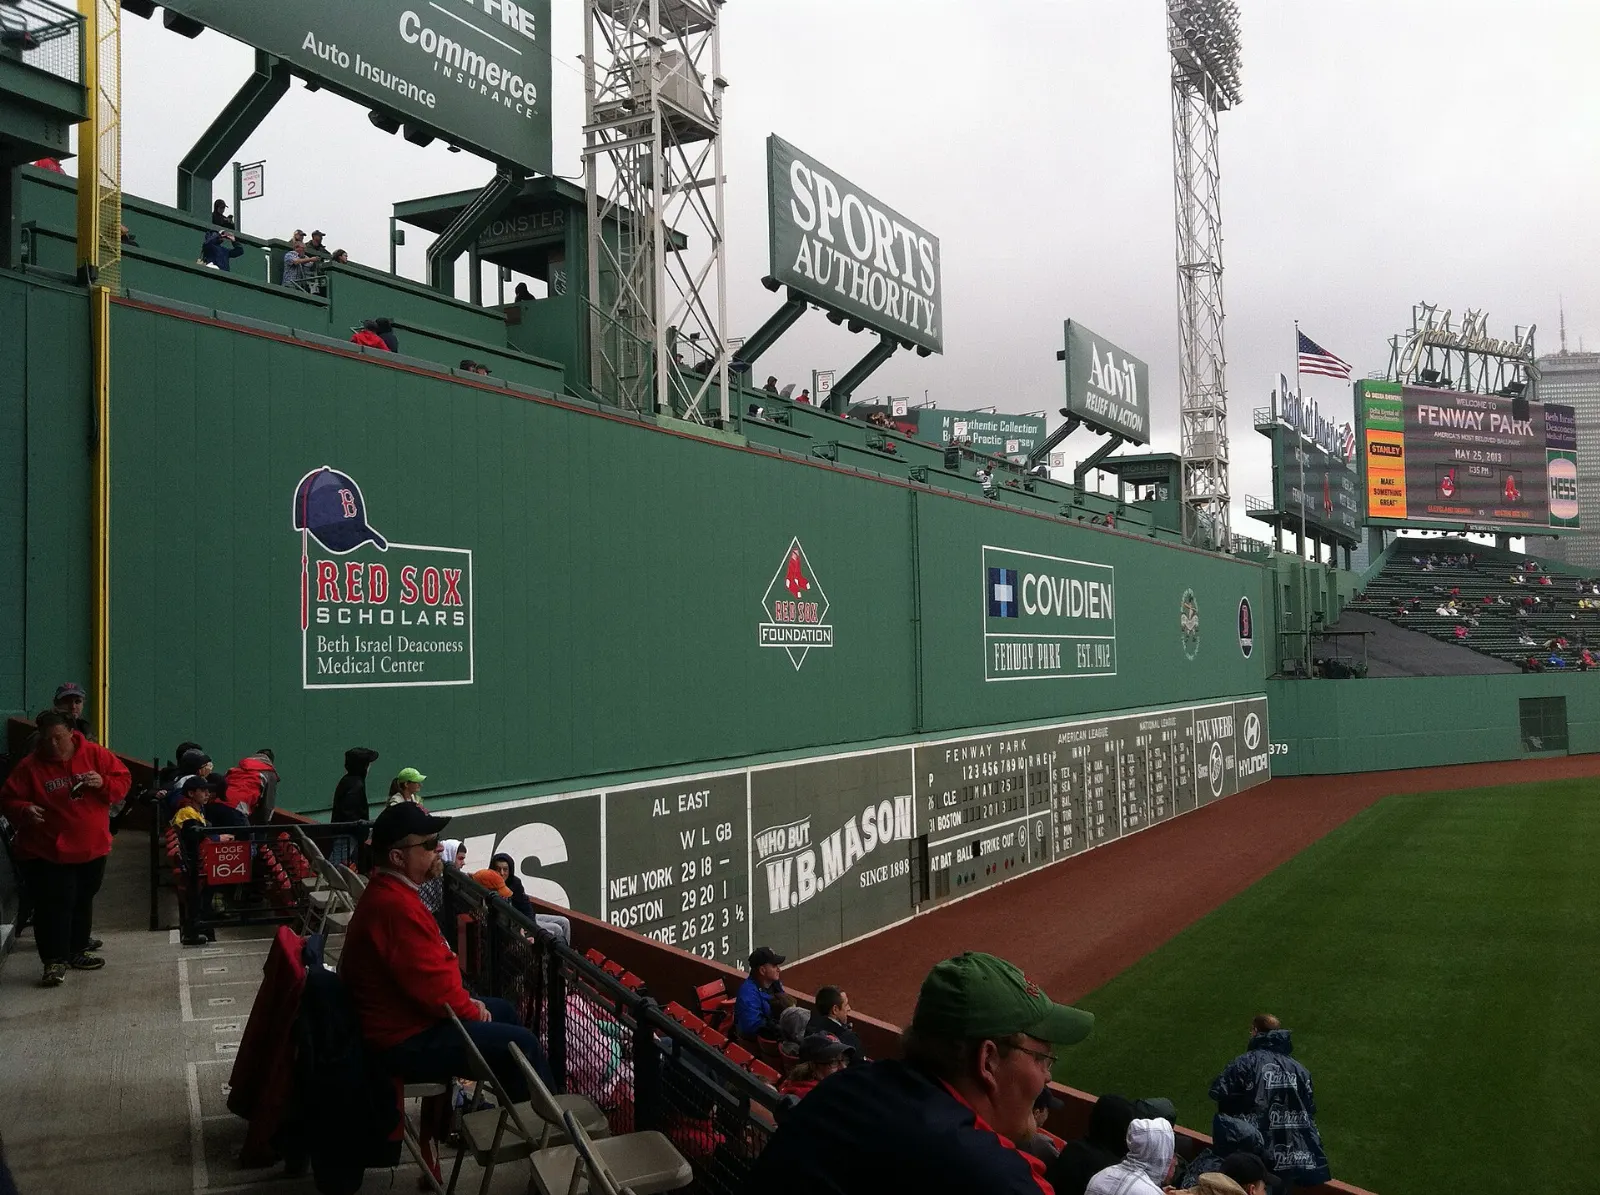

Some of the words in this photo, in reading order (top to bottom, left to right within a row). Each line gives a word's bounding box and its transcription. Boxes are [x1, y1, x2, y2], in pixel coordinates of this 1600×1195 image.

[400, 10, 537, 106] Commerce
[301, 31, 350, 69] Auto
[355, 54, 436, 109] Insurance
[433, 61, 533, 119] INSURANCE
[247, 181, 256, 195] 2
[479, 209, 564, 239] MONSTER
[790, 159, 935, 296] SPORTS
[792, 233, 936, 337] AUTHORITY
[822, 381, 830, 390] 5
[1087, 341, 1138, 407] Advil
[896, 407, 903, 415] 6
[1085, 392, 1108, 416] RELIEF
[1108, 402, 1119, 420] IN
[1118, 408, 1143, 432] ACTION
[1455, 397, 1487, 409] WELCOME
[1488, 402, 1496, 410] TO
[1000, 420, 1038, 434] Collection
[1417, 404, 1485, 431] FENWAY
[1490, 413, 1534, 437] PARK
[973, 432, 1003, 445] Practic
[1371, 444, 1401, 454] STANLEY
[1455, 448, 1470, 459] MAY
[1486, 452, 1502, 463] 2013
[1380, 477, 1395, 486] MAKE
[1481, 467, 1489, 475] PM
[1550, 476, 1576, 500] HESS
[316, 559, 389, 604] RED
[400, 565, 463, 607] SOX
[1022, 573, 1112, 619] COVIDIEN
[316, 607, 464, 626] SCHOLARS
[775, 600, 796, 622] RED
[798, 601, 818, 623] SOX
[317, 634, 350, 653] Beth
[355, 635, 392, 653] Israel
[398, 636, 463, 653] Deaconess
[762, 628, 831, 642] FOUNDATION
[317, 657, 375, 675] Medical
[380, 656, 425, 673] Center
[994, 643, 1034, 671] FENWAY
[1038, 643, 1061, 670] PARK
[1058, 729, 1087, 744] AMERICAN
[1088, 727, 1109, 740] LEAGUE
[945, 744, 992, 763] FENWAY
[1000, 739, 1026, 754] PARK
[1269, 743, 1288, 755] 379
[1061, 767, 1070, 779] TEX
[1238, 753, 1268, 778] HYUNDAI
[928, 773, 934, 787] P
[1061, 780, 1071, 793] SEA
[652, 797, 670, 817] AL
[678, 790, 711, 812] EAST
[943, 790, 957, 807] CLE
[1001, 779, 1011, 793] 25
[937, 811, 962, 831] BOSTON
[680, 829, 696, 850] W
[702, 827, 710, 846] L
[716, 822, 732, 842] GB
[756, 828, 786, 859] WHO
[788, 821, 811, 849] BUT
[1063, 837, 1073, 851] DET
[215, 845, 244, 854] LOGE
[219, 853, 240, 861] BOX
[930, 856, 940, 872] AT
[940, 851, 952, 869] BAT
[956, 844, 974, 863] BALL
[979, 836, 1000, 856] STRIKE
[1002, 832, 1015, 848] OUT
[212, 862, 246, 878] 164
[610, 874, 638, 900] NEW
[641, 866, 673, 892] YORK
[681, 860, 696, 883] 29
[701, 856, 712, 877] 18
[860, 865, 888, 888] SINCE
[890, 858, 910, 879] 1898
[610, 899, 664, 928] BOSTON
[681, 889, 697, 912] 29
[700, 884, 714, 906] 20
[682, 918, 697, 941] 26
[700, 912, 714, 935] 22
[722, 907, 730, 928] 3
[700, 941, 715, 960] 23
[722, 935, 729, 955] 5
